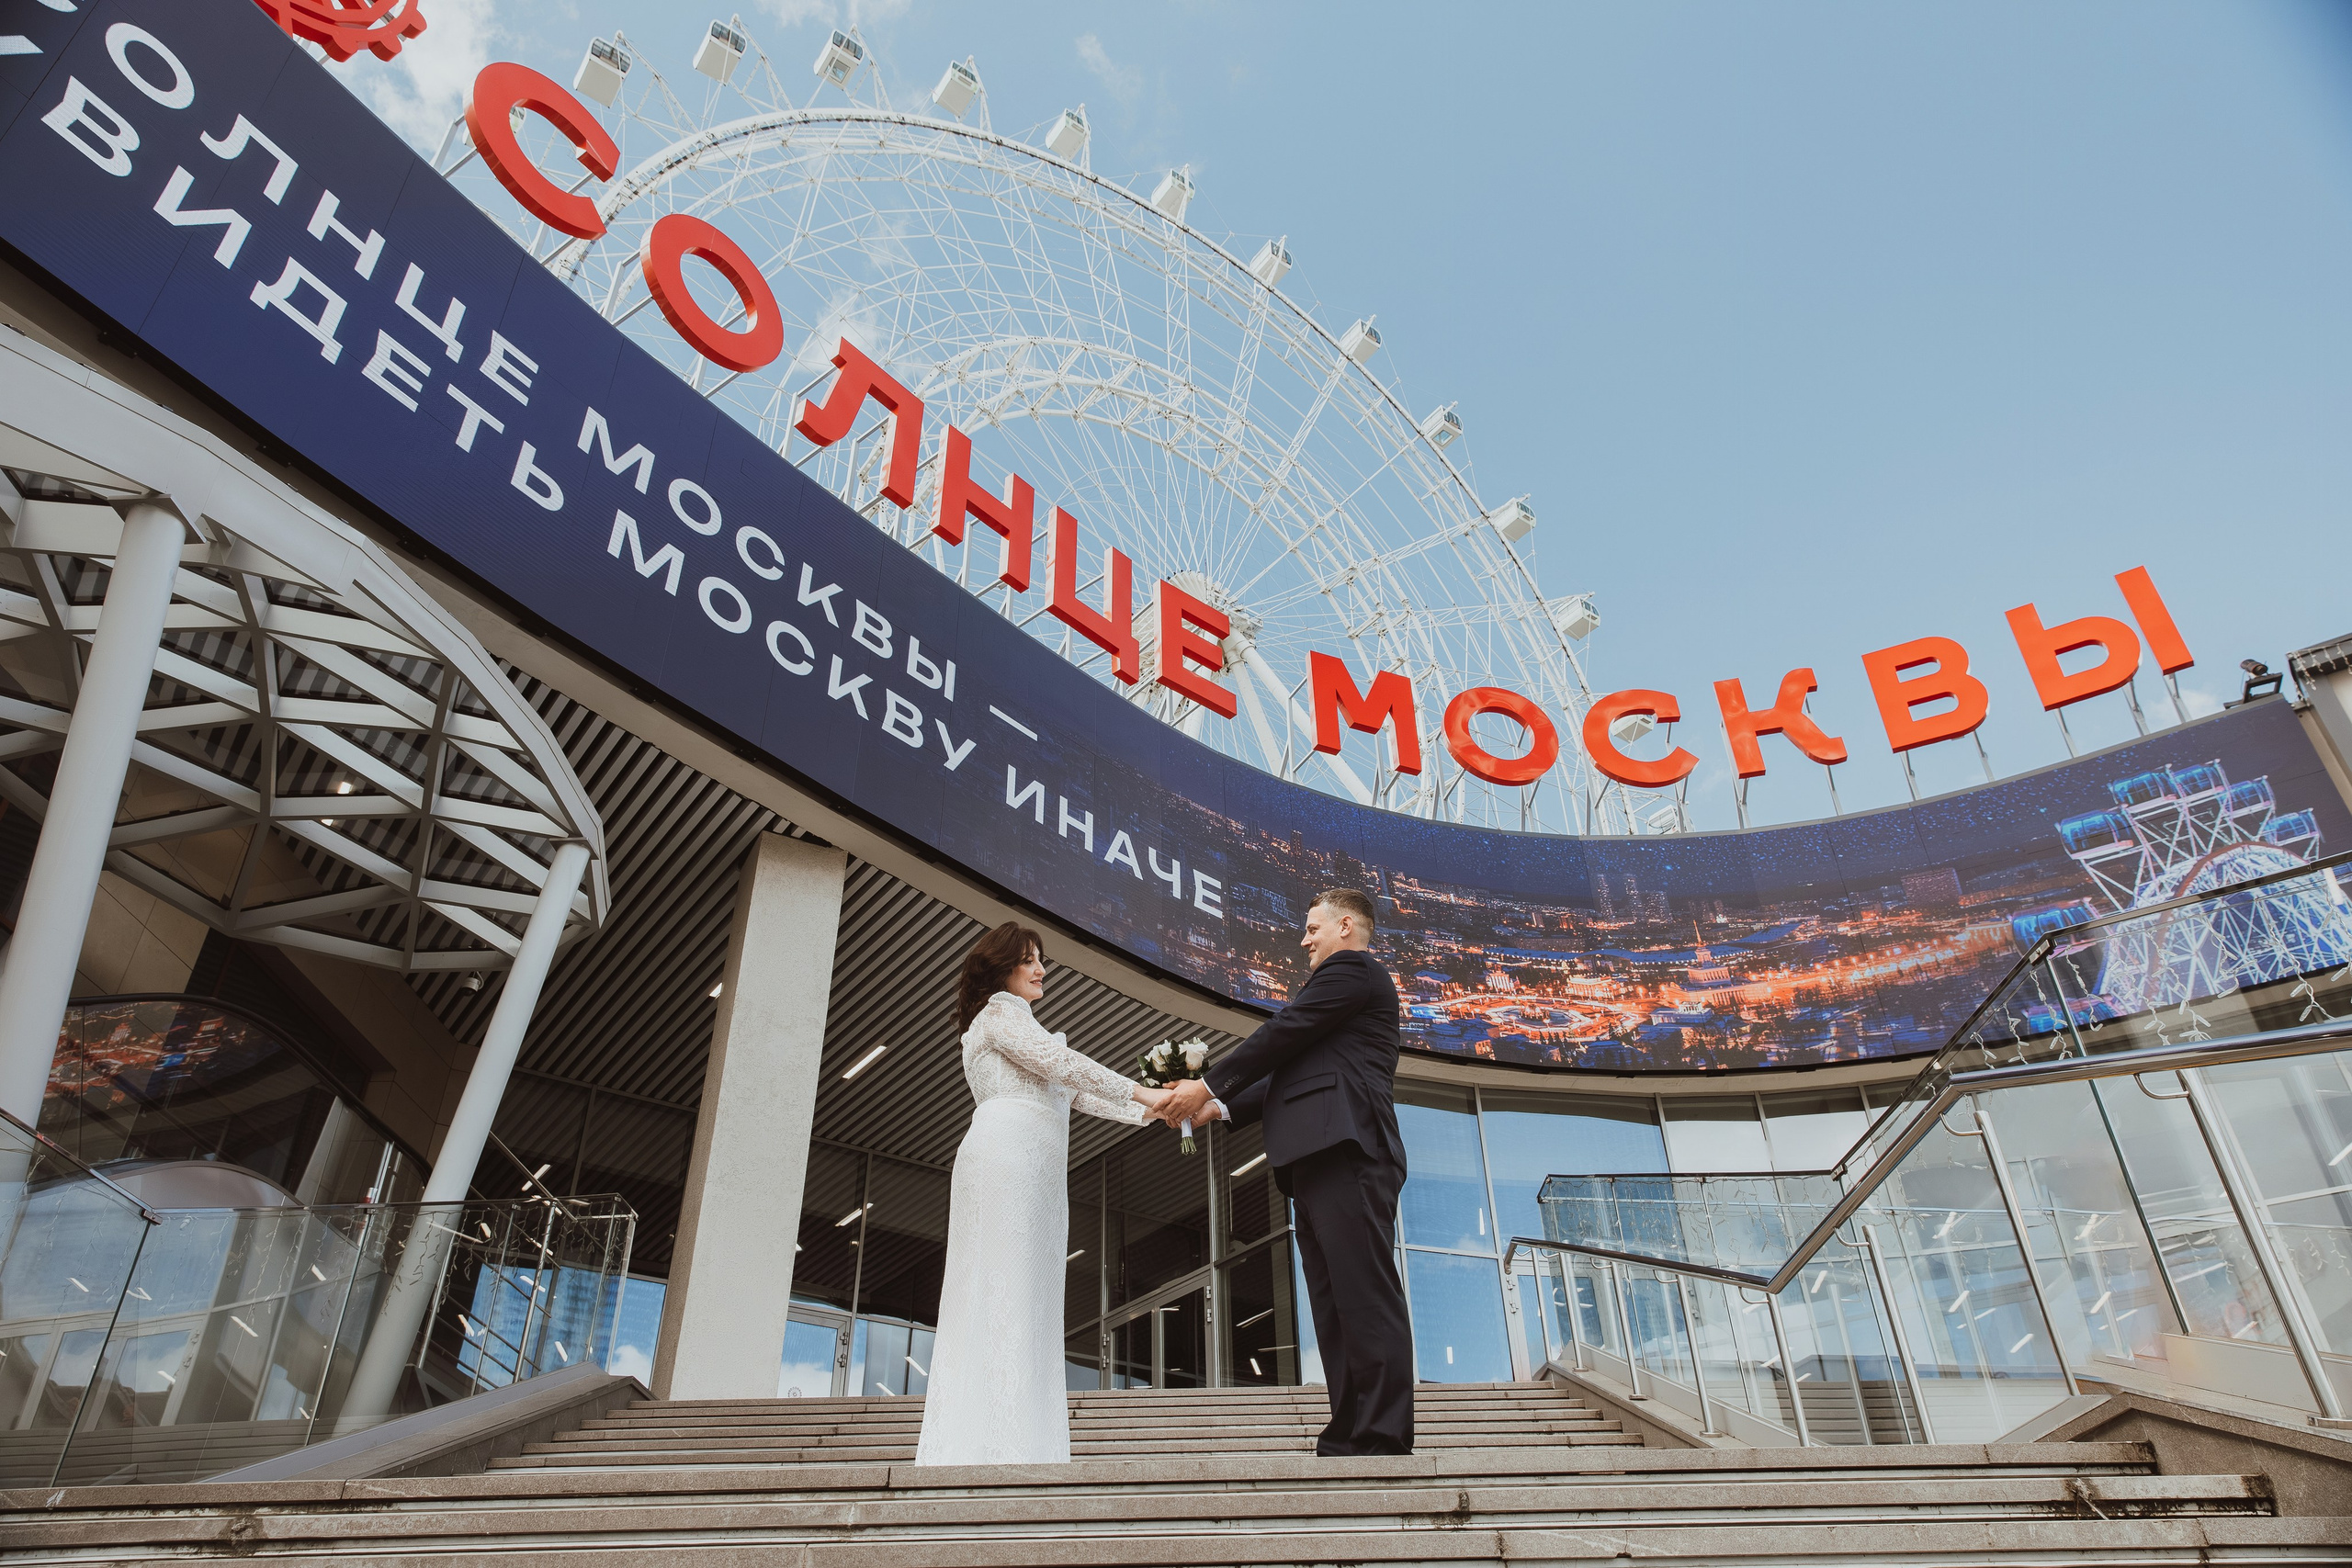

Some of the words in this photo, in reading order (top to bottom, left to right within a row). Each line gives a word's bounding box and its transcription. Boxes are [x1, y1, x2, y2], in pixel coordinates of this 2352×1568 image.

[0, 35, 564, 512] ВИДЕТЬ
[606, 508, 978, 772] МОСКВУ
[1005, 763, 1225, 919] ИНАЧЕ
[37, 0, 539, 407] ОЛНЦЕ
[578, 406, 956, 703] МОСКВЫ
[465, 61, 1238, 719] СОЛНЦЕ
[1310, 565, 2194, 788] МОСКВЫ
